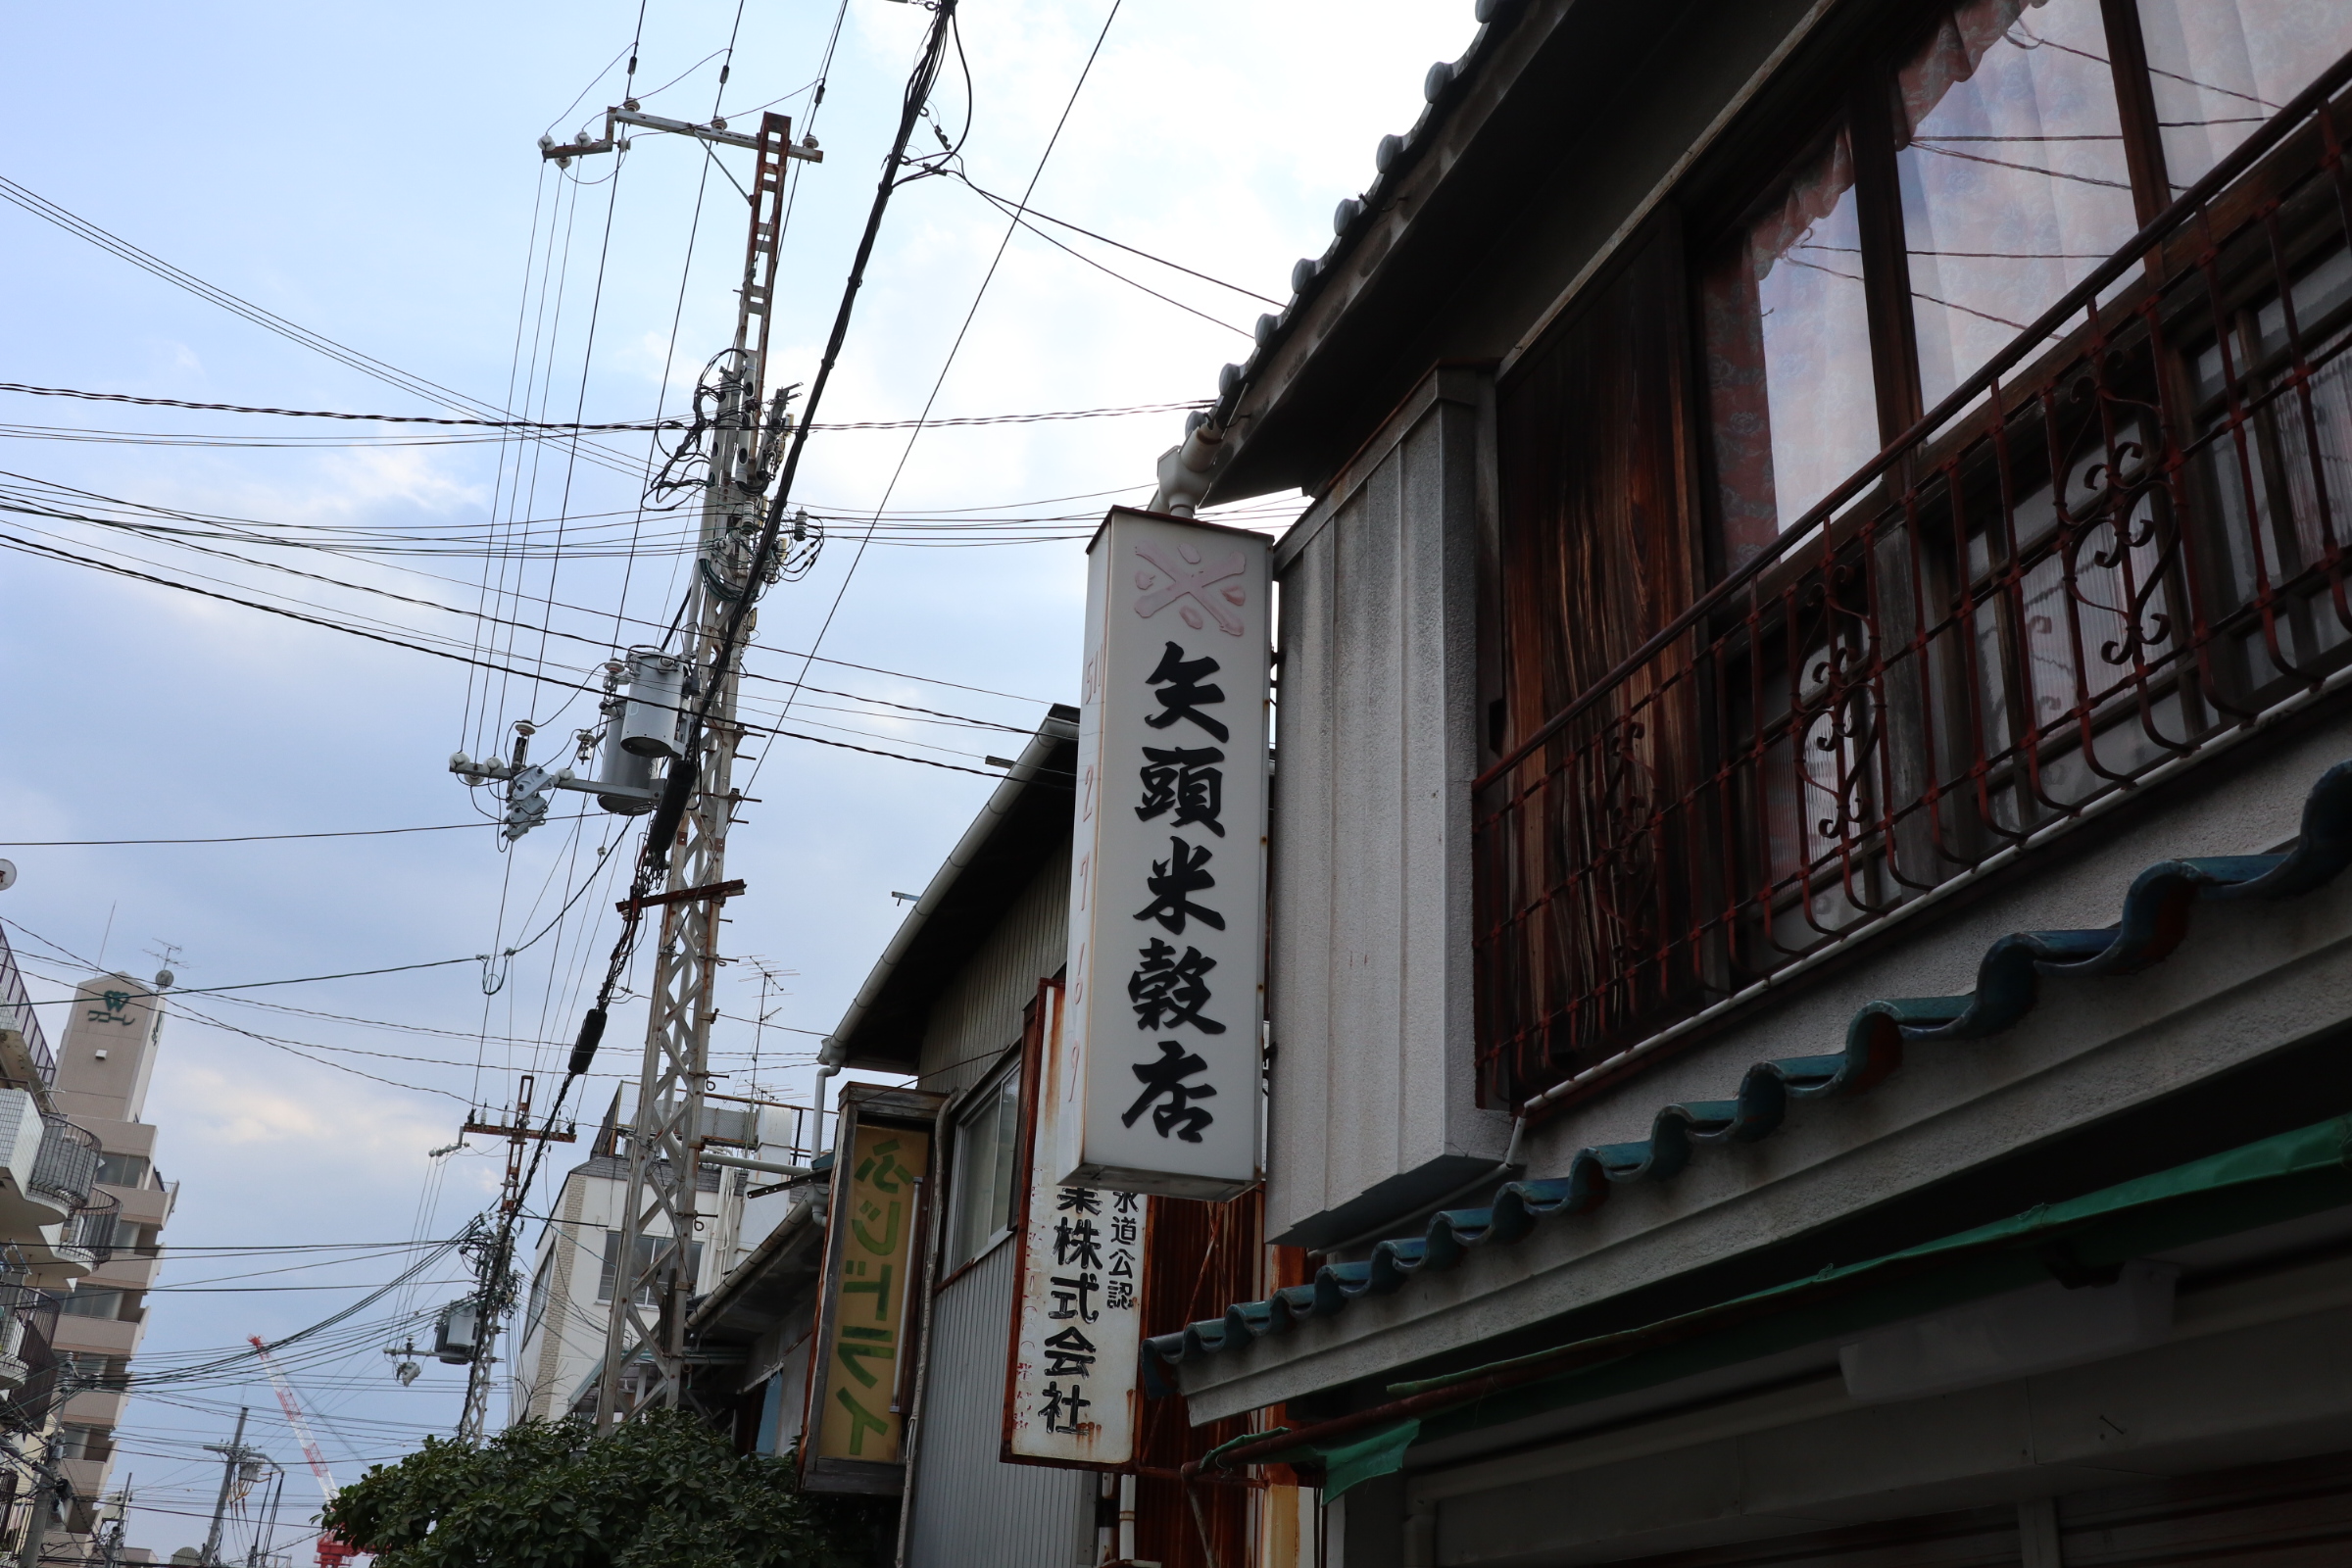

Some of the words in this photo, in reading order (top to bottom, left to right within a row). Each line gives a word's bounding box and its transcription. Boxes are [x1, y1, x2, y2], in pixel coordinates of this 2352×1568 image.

[88, 1010, 135, 1026] ワコーレ
[1121, 640, 1230, 1144] 矢頭米穀店
